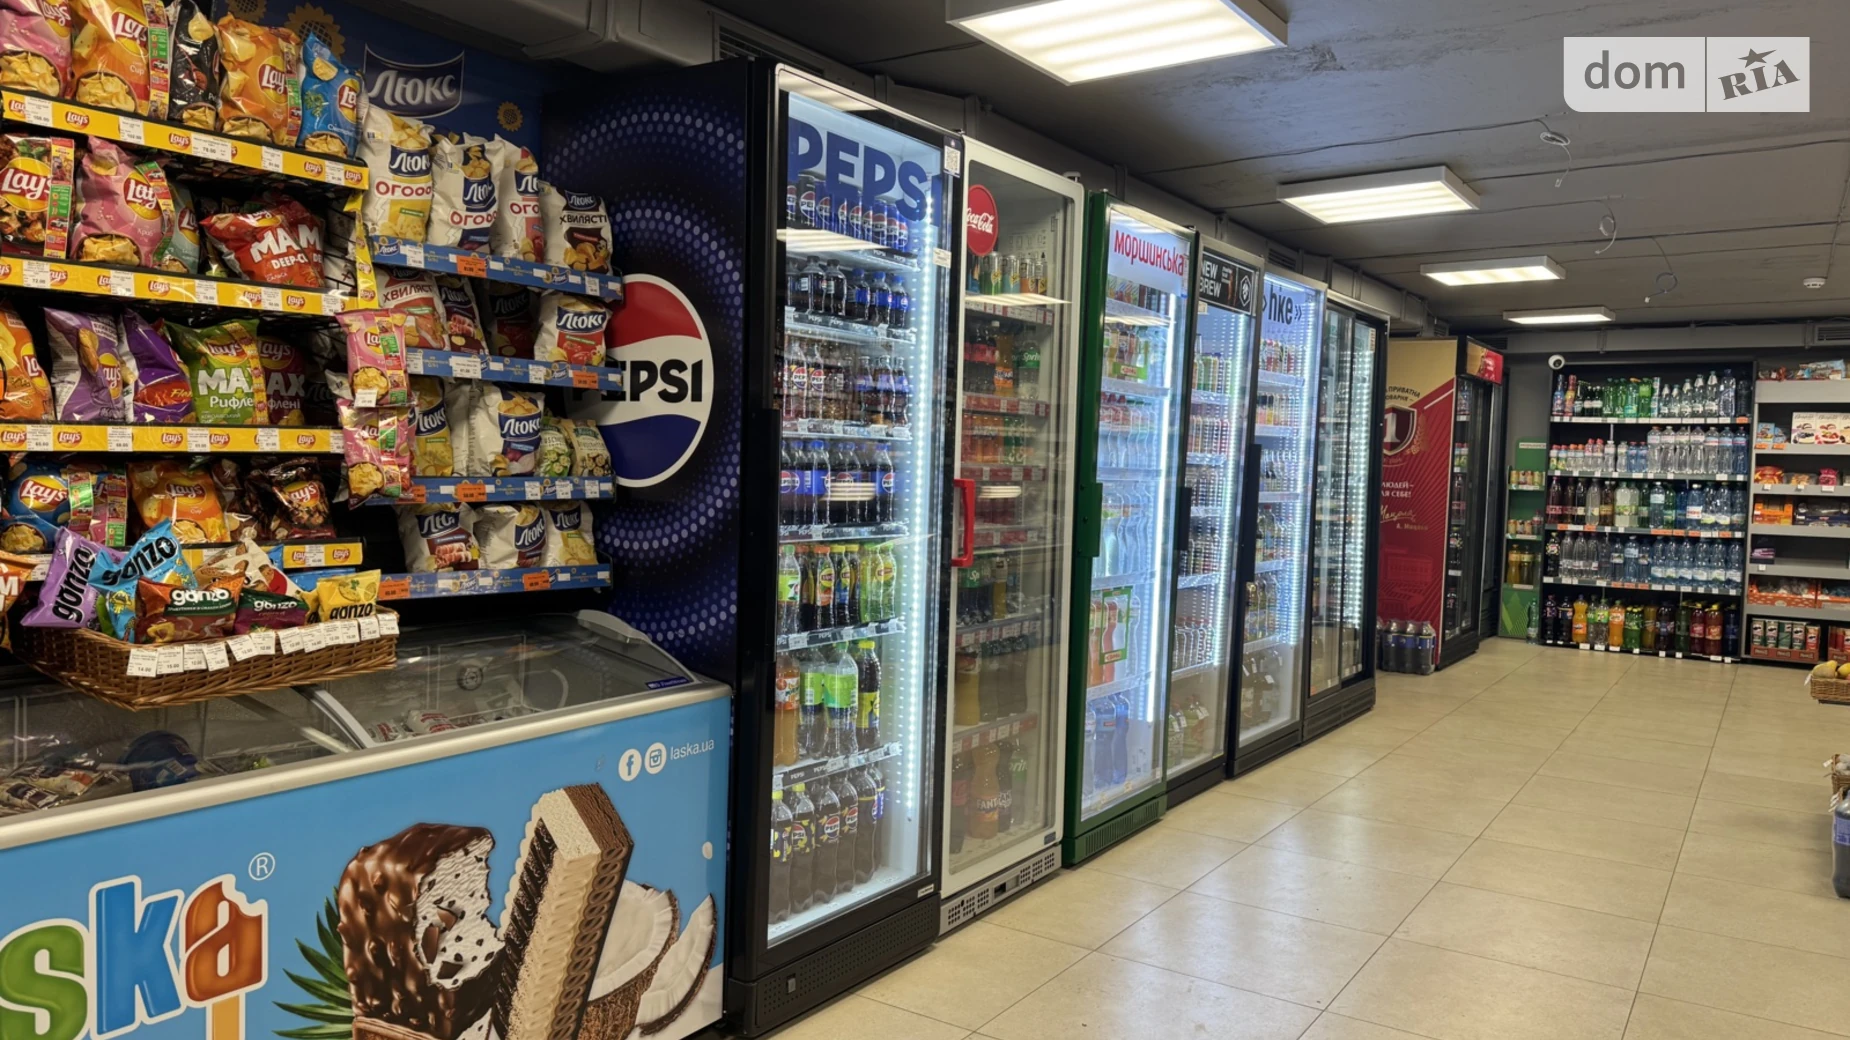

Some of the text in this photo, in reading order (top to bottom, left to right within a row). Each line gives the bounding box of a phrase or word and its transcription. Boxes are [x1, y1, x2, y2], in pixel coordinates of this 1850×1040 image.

[368, 70, 457, 107] Люкс
[788, 117, 941, 228] PEPSI
[573, 359, 703, 403] EPSI
[669, 736, 716, 762] laska.ua
